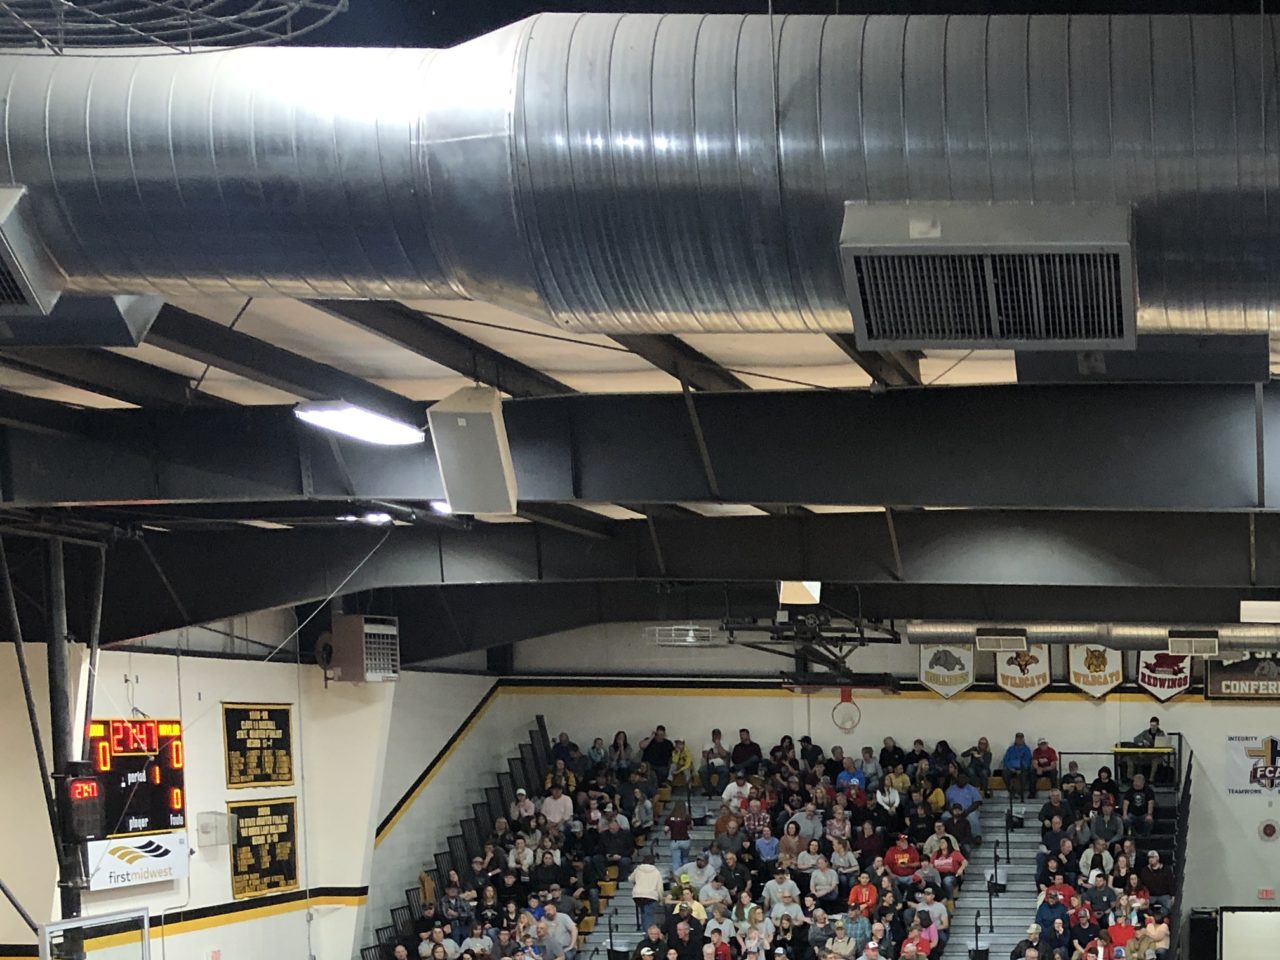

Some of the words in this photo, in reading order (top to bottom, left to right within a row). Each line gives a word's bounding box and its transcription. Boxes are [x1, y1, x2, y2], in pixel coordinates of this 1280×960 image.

[1000, 672, 1048, 688] WILDCATS
[1073, 670, 1121, 687] WILDCATS
[1140, 674, 1189, 689] REDWINGS
[112, 722, 157, 750] 27:47
[98, 741, 111, 771] 0
[171, 740, 183, 769] 0
[127, 769, 147, 784] period
[172, 788, 182, 809] 0
[128, 816, 149, 831] player
[109, 866, 173, 884] firstmidwest
